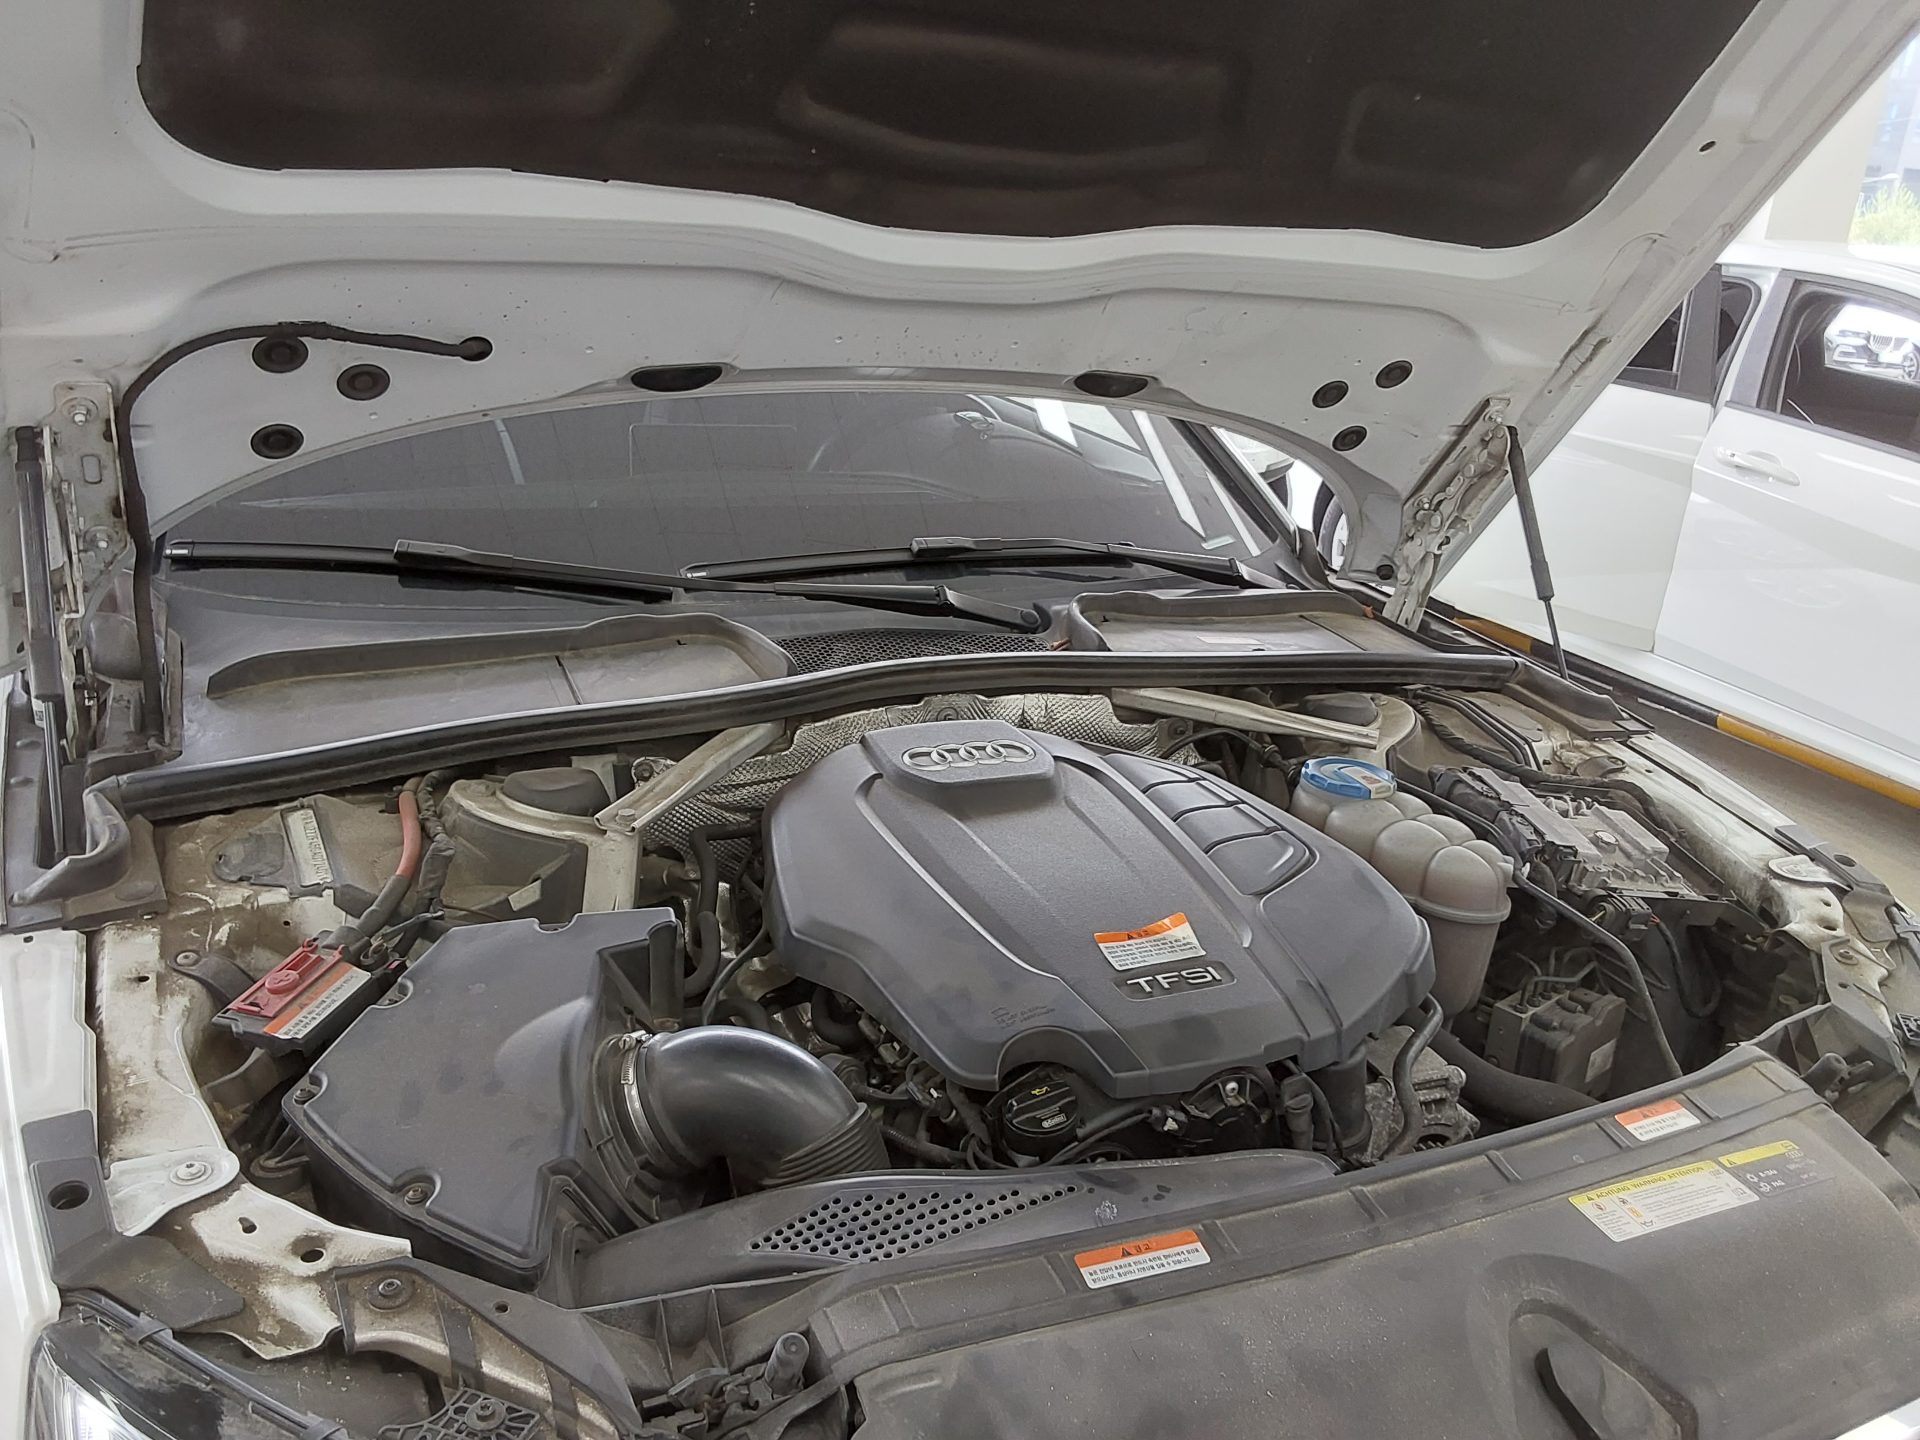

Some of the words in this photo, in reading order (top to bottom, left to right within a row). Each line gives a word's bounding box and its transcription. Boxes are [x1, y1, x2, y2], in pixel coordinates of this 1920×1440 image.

[1126, 966, 1223, 994] TFSI
[1595, 1185, 1629, 1199] ACHTUNG
[1631, 1175, 1666, 1189] WARNING
[1667, 1166, 1705, 1180] ATTENTION
